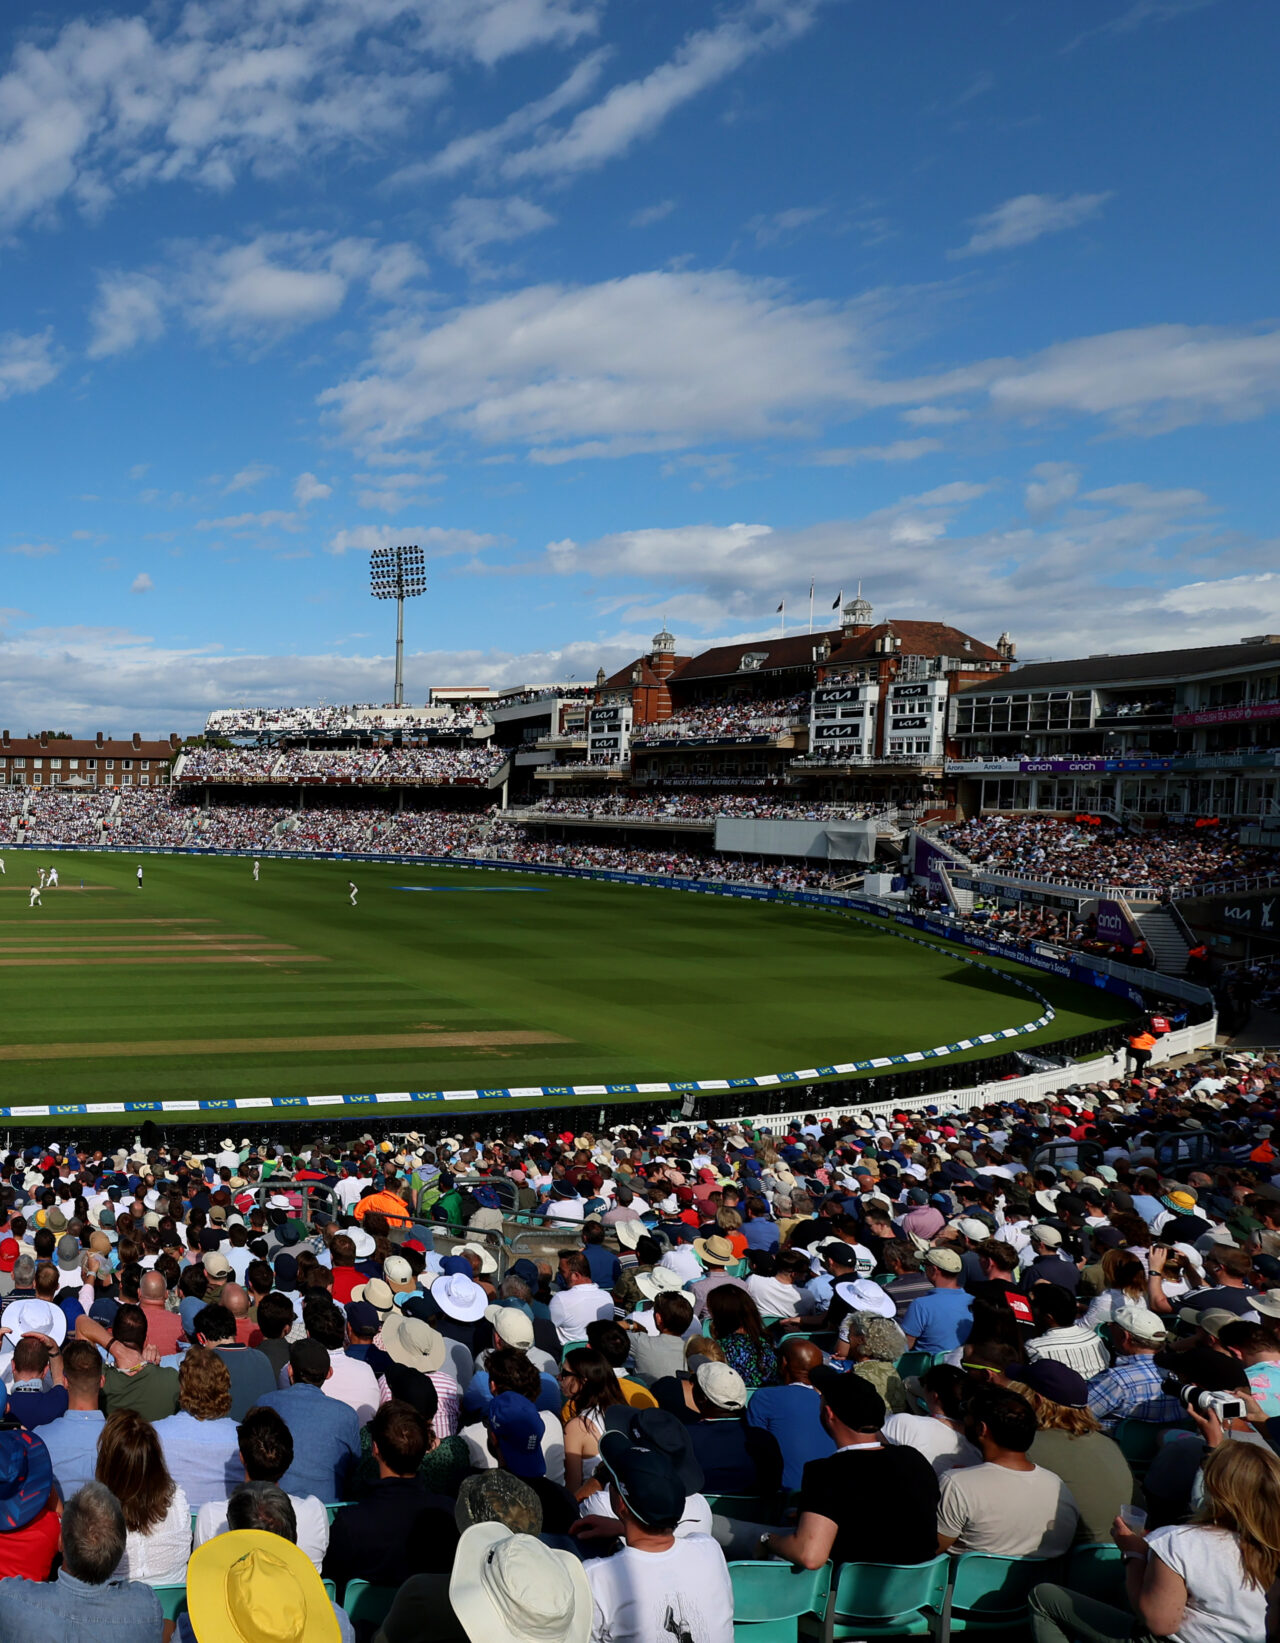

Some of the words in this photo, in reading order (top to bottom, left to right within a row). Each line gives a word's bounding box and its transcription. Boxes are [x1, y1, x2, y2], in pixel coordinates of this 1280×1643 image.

[983, 763, 1003, 771] Arora
[1027, 763, 1053, 772] cinch
[1068, 761, 1096, 772] cinch
[1098, 910, 1122, 930] cinch
